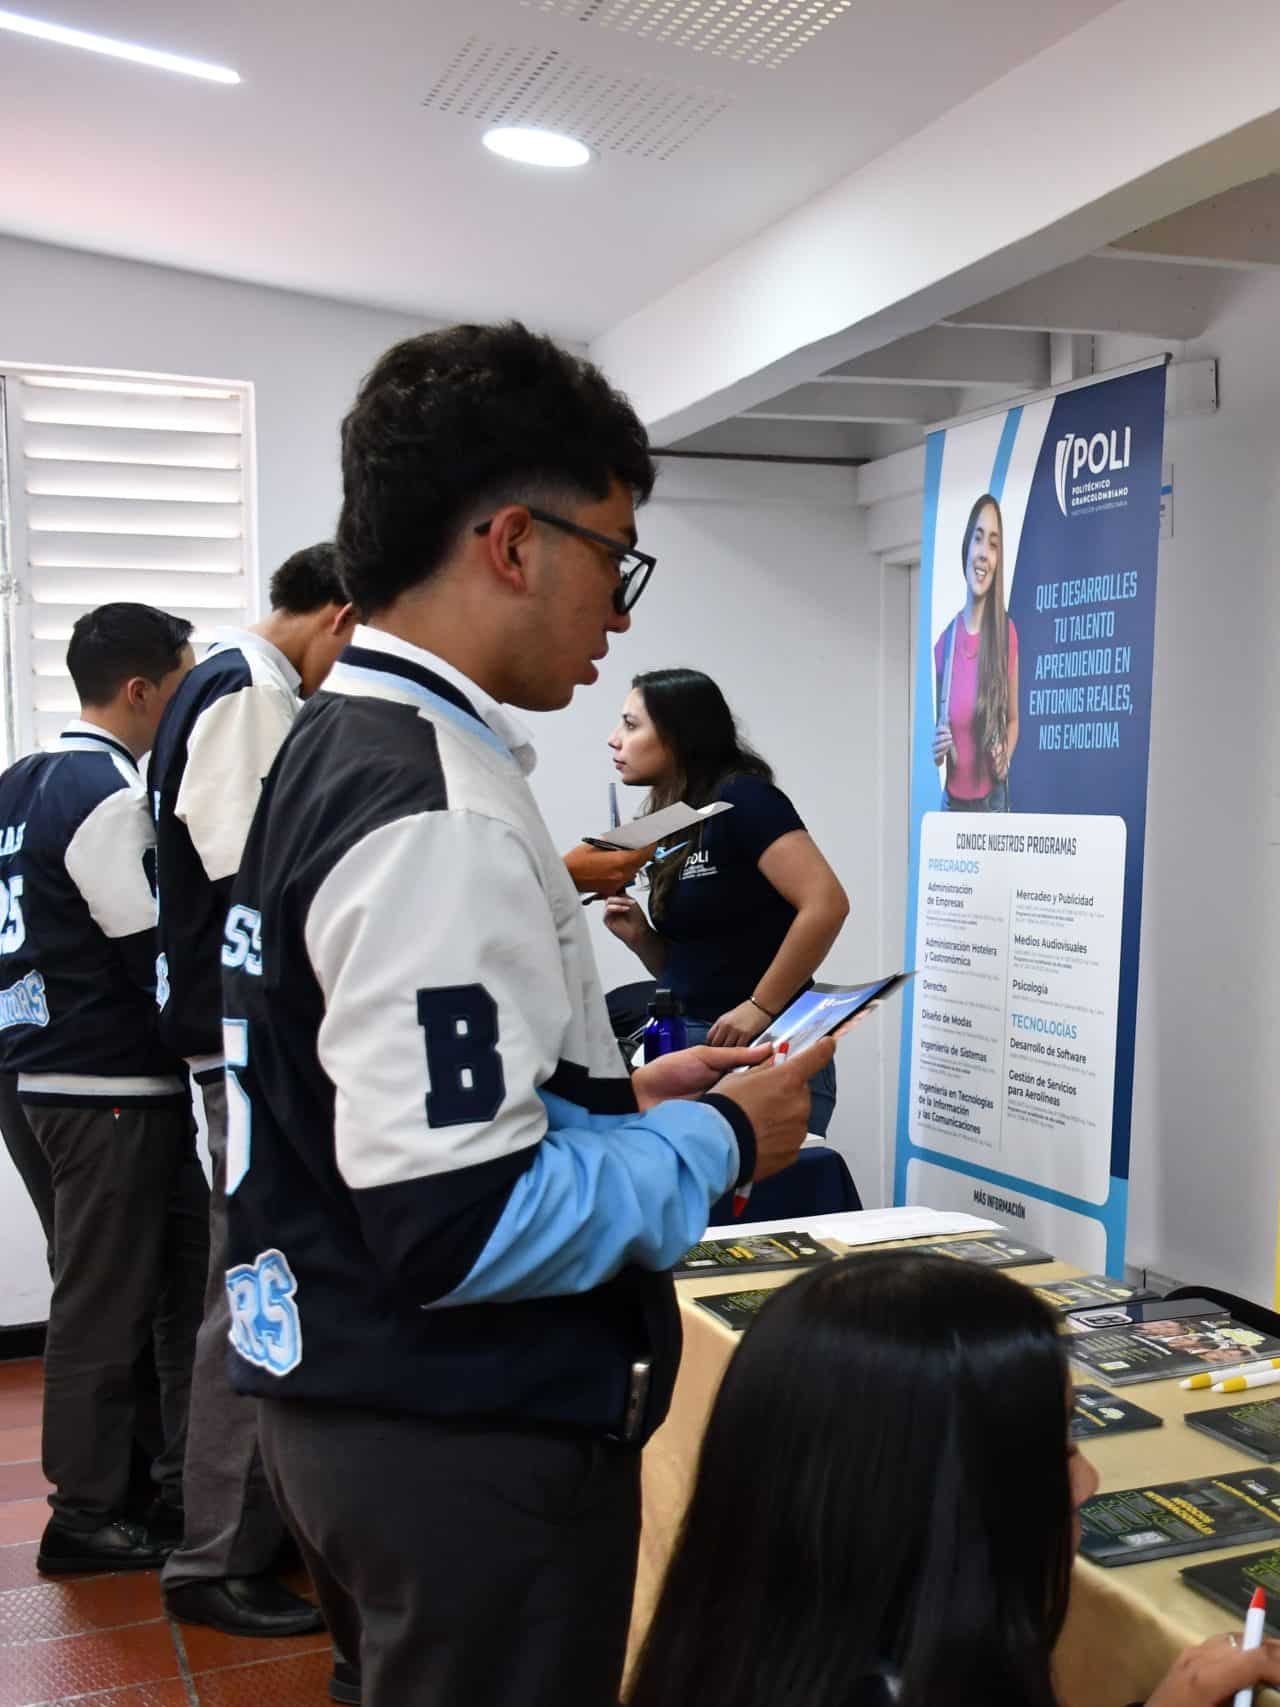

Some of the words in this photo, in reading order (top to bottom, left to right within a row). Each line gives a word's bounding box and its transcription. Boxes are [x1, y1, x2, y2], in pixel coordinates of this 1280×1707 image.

[1073, 426, 1131, 479] POLI
[1072, 480, 1111, 496] POLITÉCNICO
[1072, 487, 1128, 506] GRANCOLOMBIANO
[1036, 583, 1059, 613] QUE
[1061, 571, 1137, 608] DESARROLLES
[1054, 617, 1067, 643] TU
[1070, 611, 1115, 642] TALENTO
[1035, 649, 1111, 680] APRENDIENDO
[1115, 646, 1131, 674] EN
[1029, 687, 1085, 716] ENTORNOS
[1087, 684, 1133, 715] REALES,
[1039, 724, 1061, 750] NOS
[1063, 721, 1120, 749] EMOCIONA
[956, 833, 986, 850] CONOCE
[988, 834, 1024, 853] NUESTROS
[1027, 836, 1077, 856] PROGRAMAS
[928, 858, 979, 874] PREGRADOS
[927, 897, 934, 905] de
[935, 896, 964, 909] Empresas
[1016, 889, 1050, 903] Mercadeo
[1052, 896, 1057, 905] y
[1059, 893, 1094, 906] Publicidad
[972, 944, 997, 956] Hotelera
[1014, 934, 1040, 948] Medios
[1042, 938, 1088, 954] Audiovisuales
[924, 953, 928, 962] y
[922, 980, 947, 992] Derecho
[922, 1009, 942, 1023] Diseño
[942, 1014, 950, 1024] de
[951, 1015, 972, 1028] Modas
[1011, 1013, 1078, 1039] TECNOLOGÍAS
[416, 982, 506, 1129] B
[950, 1046, 958, 1057] de
[960, 1047, 987, 1062] Sistemas
[1010, 1038, 1045, 1055] Desarrollo
[1046, 1046, 1055, 1056] de
[1057, 1047, 1087, 1064] Software
[1008, 1086, 1023, 1098] para
[1009, 1070, 1035, 1085] Gestión
[1036, 1077, 1046, 1088] de
[1047, 1078, 1077, 1095] Servicios
[918, 1095, 926, 1104] de
[926, 1097, 932, 1106] la
[949, 1089, 957, 1098] en
[922, 1110, 931, 1120] las
[932, 1112, 981, 1135] Comunicaciones
[974, 1189, 986, 1206] MÁS
[987, 1194, 1026, 1219] INFORMACIÓN
